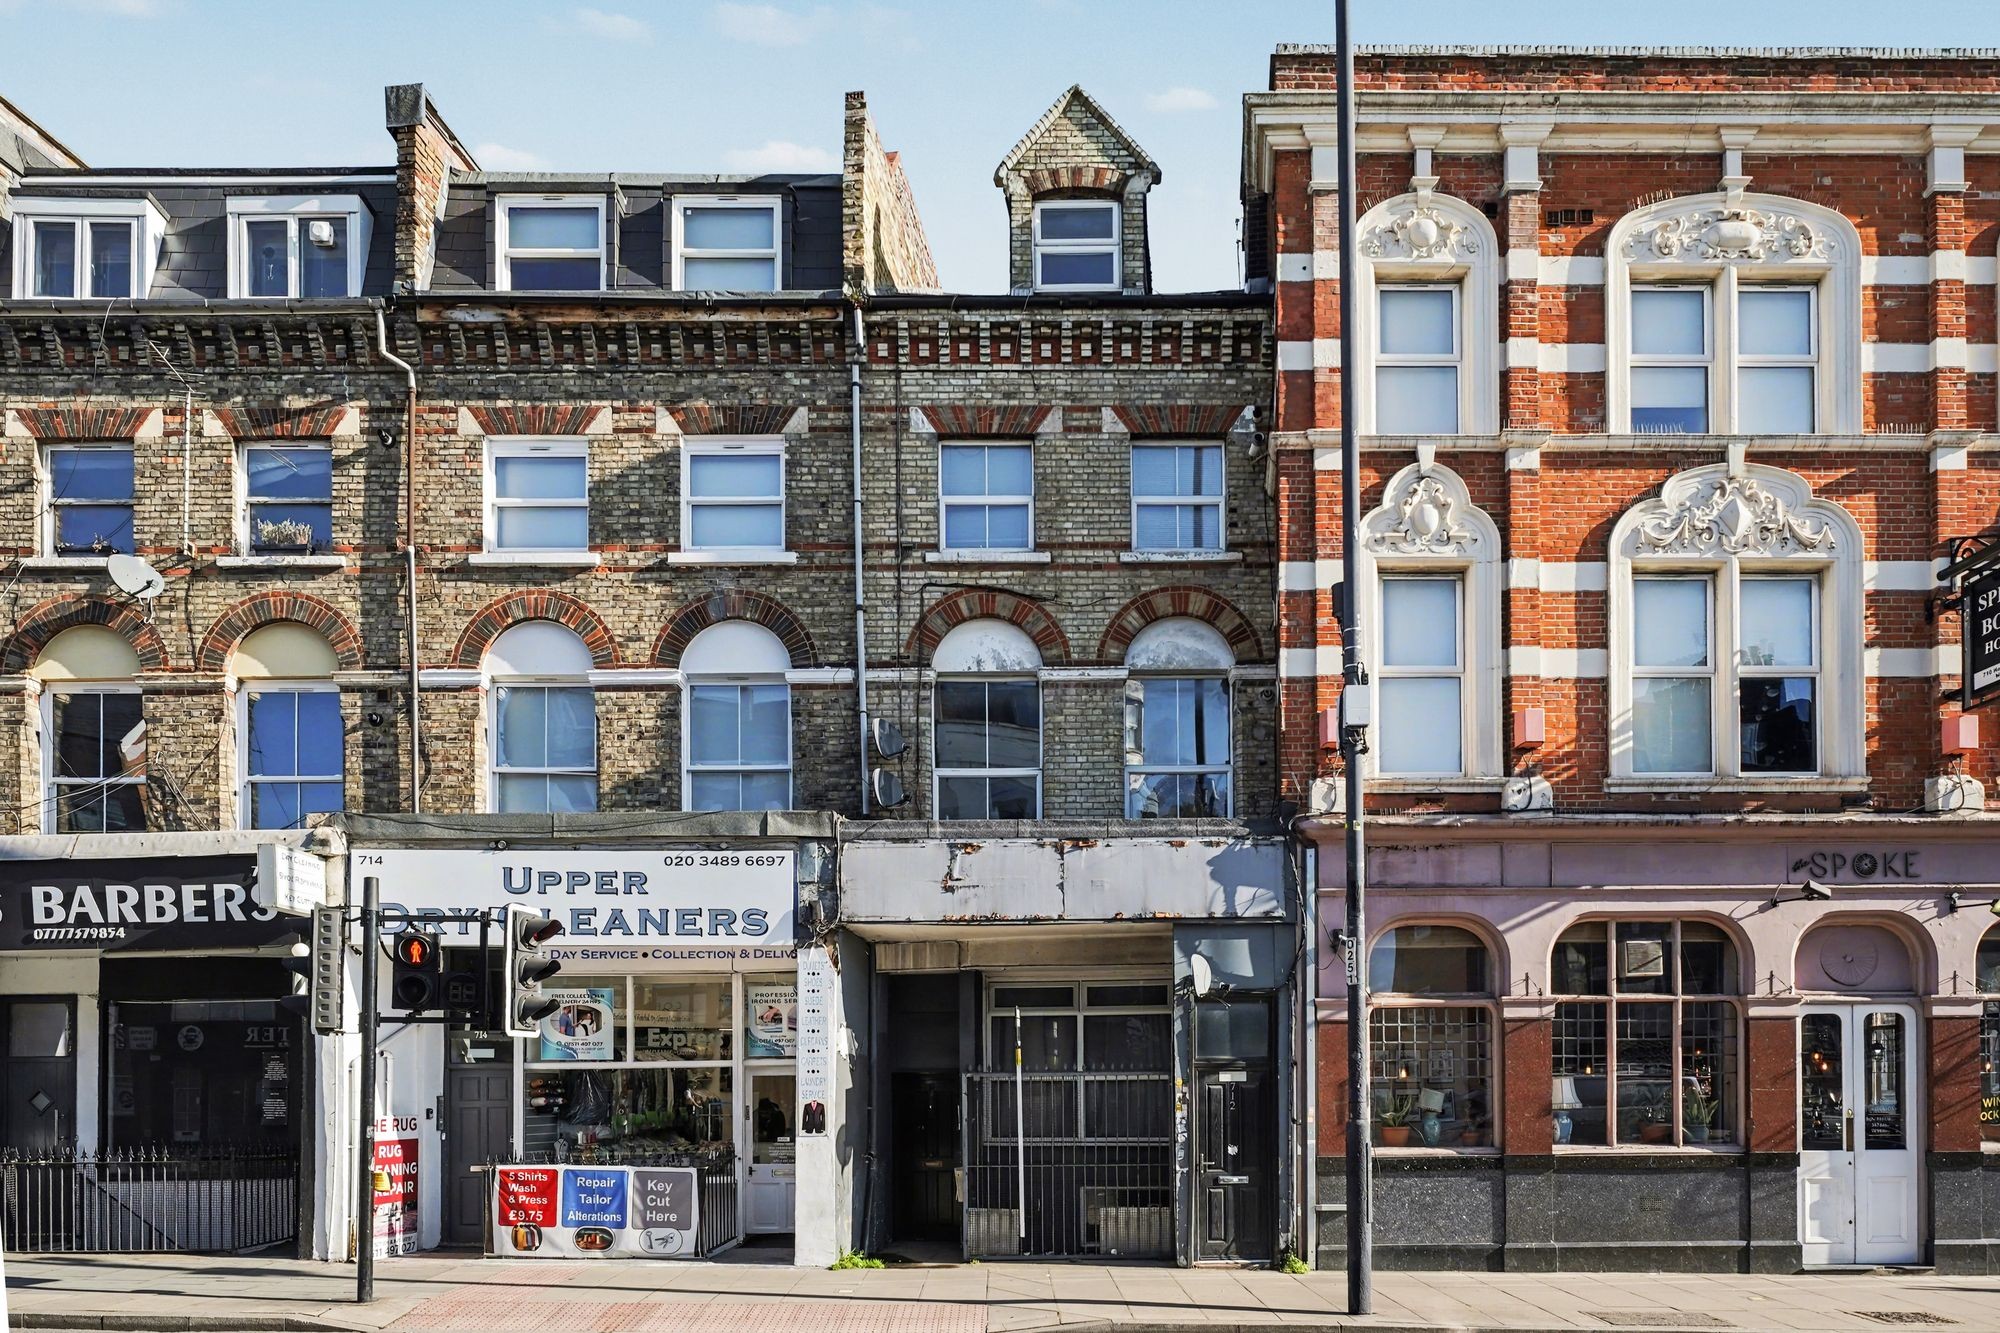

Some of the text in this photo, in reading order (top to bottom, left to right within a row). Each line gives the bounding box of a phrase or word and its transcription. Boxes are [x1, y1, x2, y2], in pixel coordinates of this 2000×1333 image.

[1978, 586, 2000, 612] SP
[358, 855, 383, 865] 714
[664, 856, 785, 866] 020 3489 6697
[1810, 852, 1921, 879] SPOKE
[503, 867, 649, 896] UPPER
[31, 885, 278, 924] BARBERS
[379, 902, 769, 937] DRY EANERS
[550, 950, 577, 960] DAY
[581, 949, 639, 959] SERVICE
[651, 949, 736, 959] COLLECTION
[739, 949, 750, 959] &
[1346, 940, 1355, 983] 0251
[801, 1090, 825, 1099] SERVICE
[373, 1117, 417, 1132] HE RUG
[378, 1144, 402, 1158] RUG
[374, 1162, 417, 1178] EANING
[508, 1172, 548, 1182] 5 Shirts
[577, 1177, 615, 1189] Repair
[508, 1183, 537, 1193] Wash
[647, 1180, 673, 1194] Key
[508, 1195, 548, 1205] & Press
[579, 1194, 612, 1205] Tailor
[646, 1195, 670, 1206] Cut
[508, 1210, 543, 1221] £9.75
[568, 1210, 622, 1222] Alterations
[646, 1210, 678, 1222] Here
[402, 1240, 416, 1253] 027
